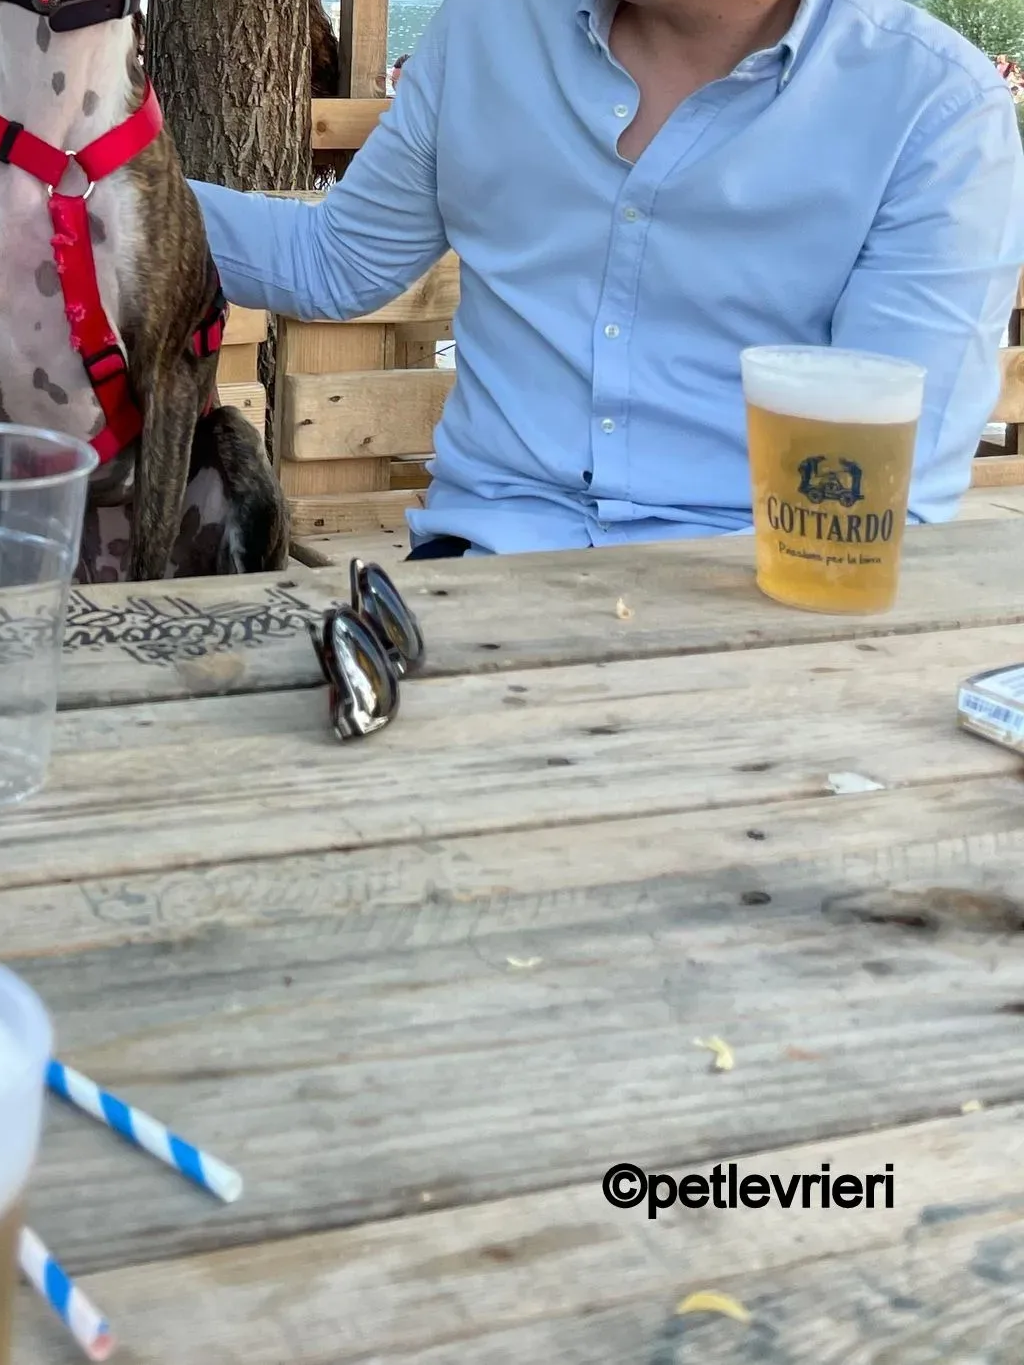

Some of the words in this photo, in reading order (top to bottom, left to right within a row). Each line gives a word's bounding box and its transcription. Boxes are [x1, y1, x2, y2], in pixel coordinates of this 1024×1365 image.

[767, 496, 893, 543] GOTTARDO
[826, 555, 843, 566] per
[847, 553, 857, 564] la
